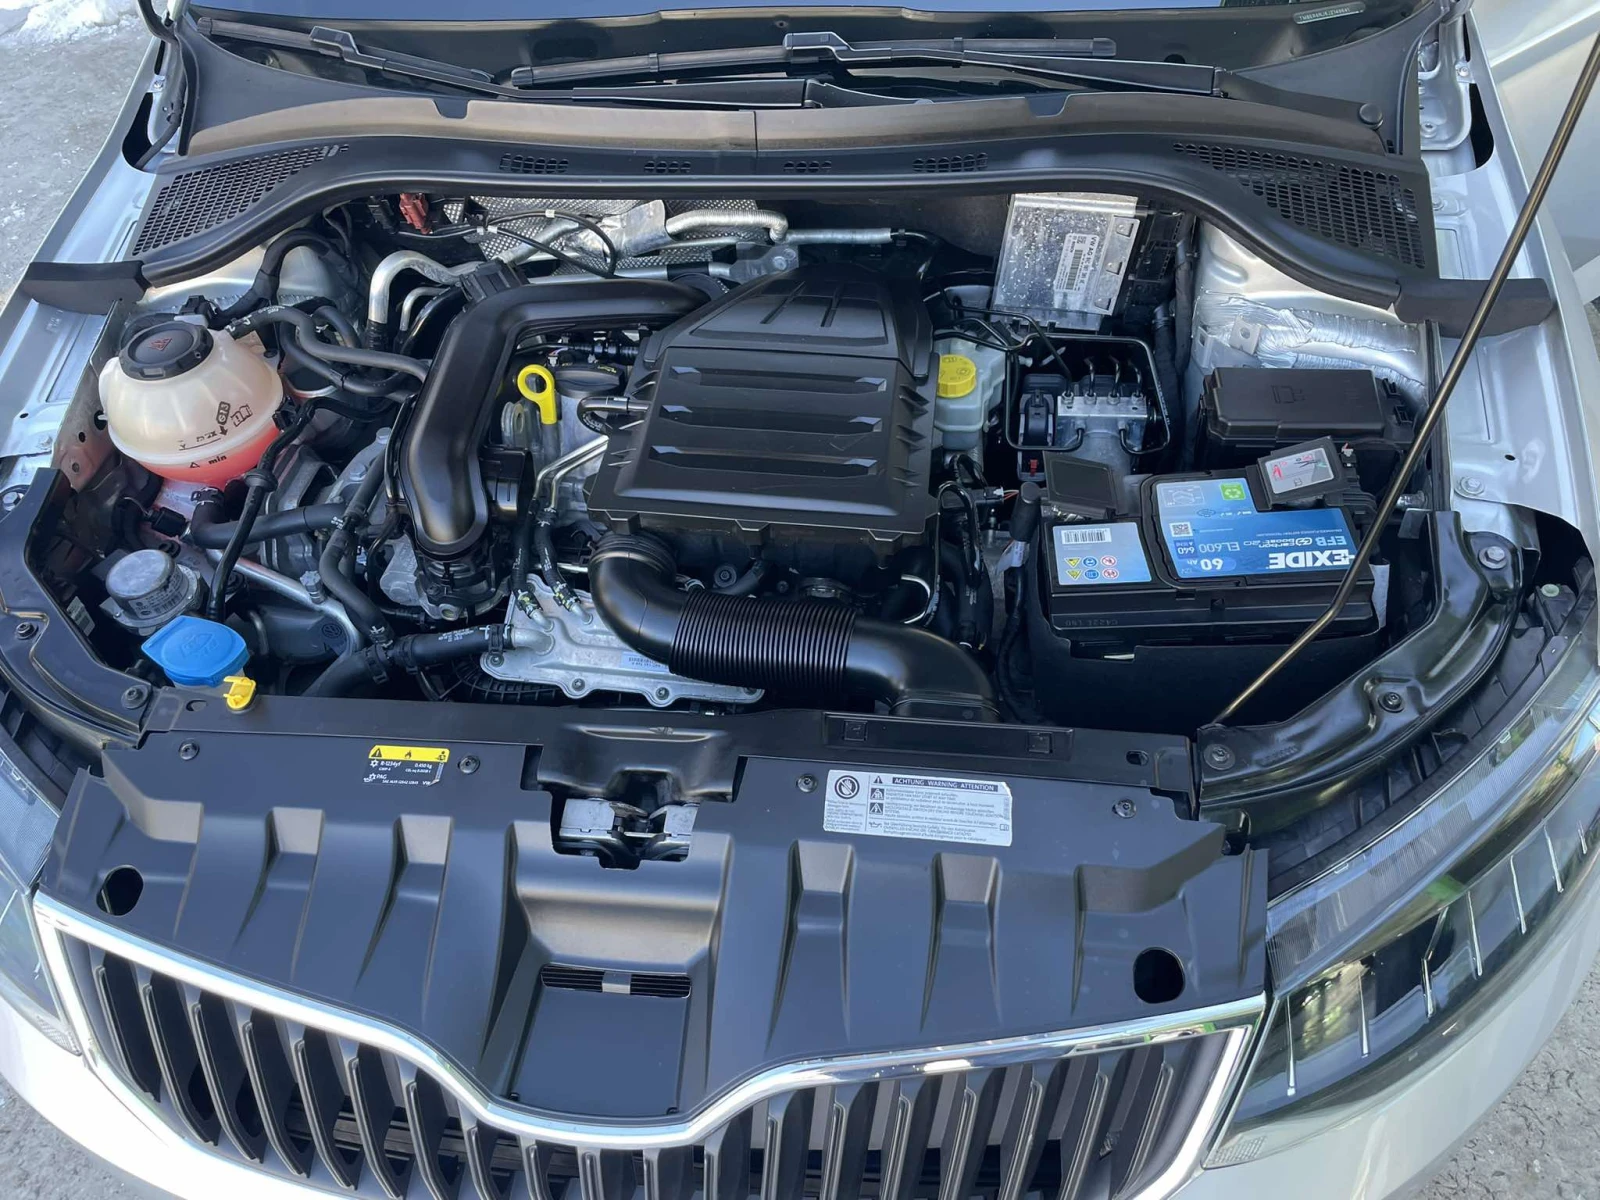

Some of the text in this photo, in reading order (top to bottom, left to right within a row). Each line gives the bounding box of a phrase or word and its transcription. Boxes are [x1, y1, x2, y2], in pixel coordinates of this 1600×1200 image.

[218, 403, 230, 422] G13
[208, 454, 227, 465] min
[1315, 536, 1347, 546] EFB
[1199, 542, 1240, 553] EL600
[1200, 558, 1223, 570] 60
[1269, 549, 1350, 569] EXIDE
